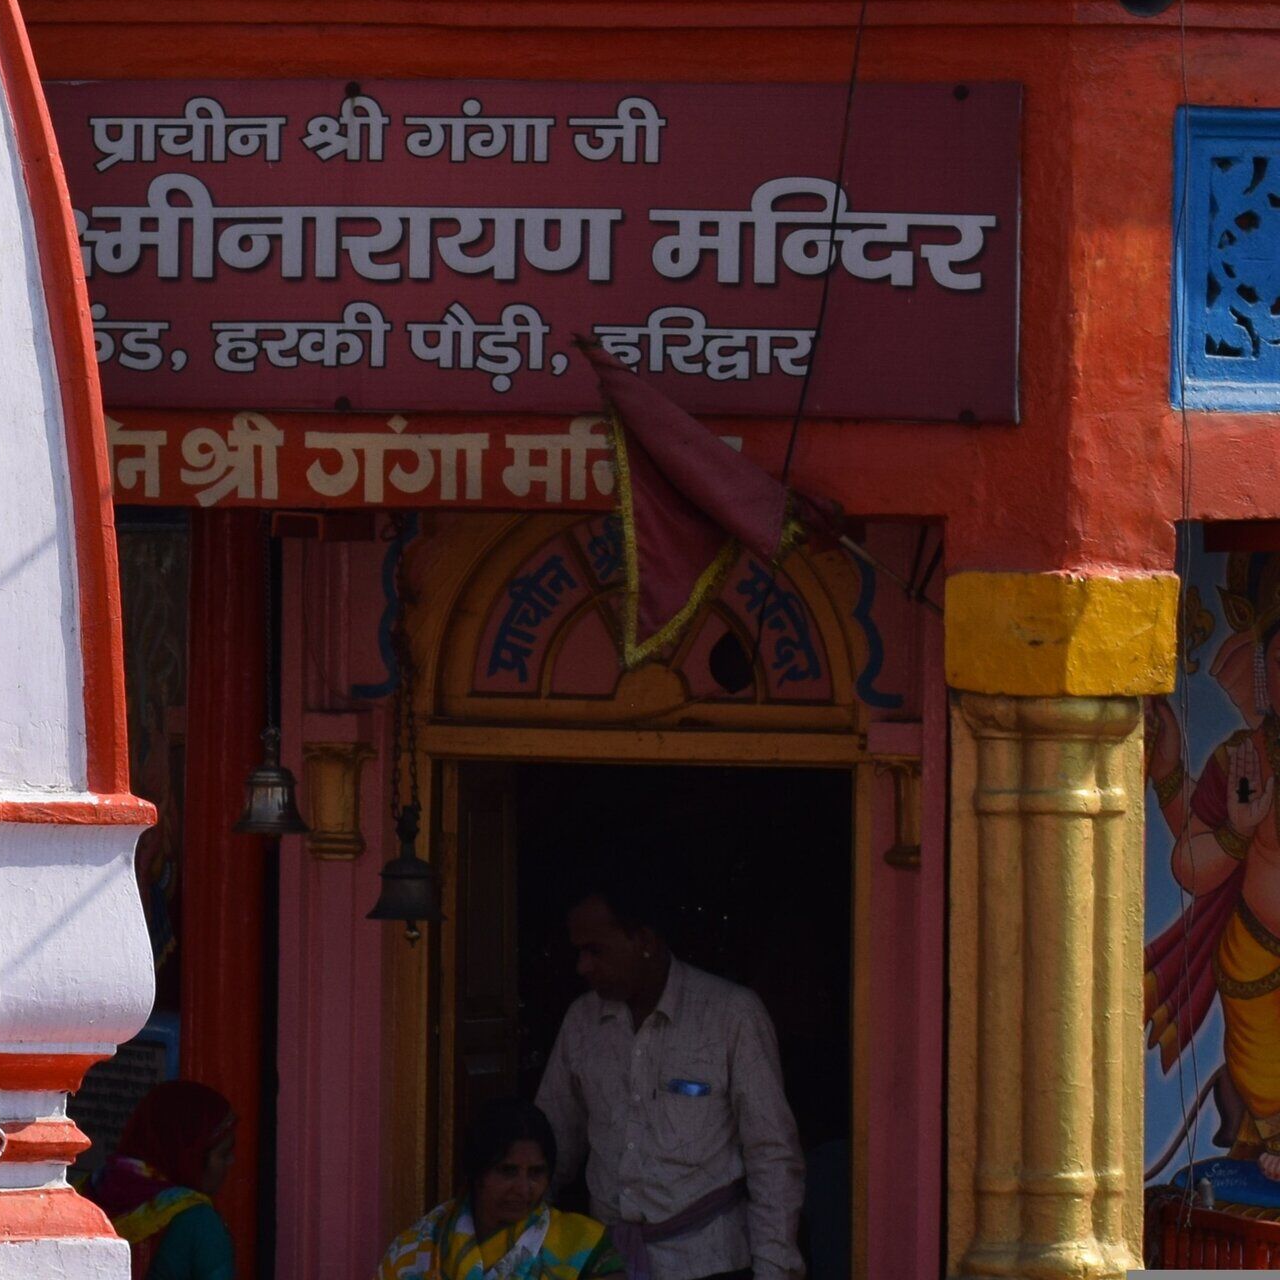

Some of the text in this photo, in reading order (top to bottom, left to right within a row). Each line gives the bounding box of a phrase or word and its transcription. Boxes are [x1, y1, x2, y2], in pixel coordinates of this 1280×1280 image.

[89, 95, 667, 172] प्राचीन श्री गंगा जी
[649, 176, 996, 290] मन्दिर
[210, 301, 392, 373] हरकी
[406, 301, 569, 393] पौड़ी,
[594, 306, 818, 382] हरिद्वार
[175, 412, 285, 507] श्री
[305, 415, 490, 503] गंगा
